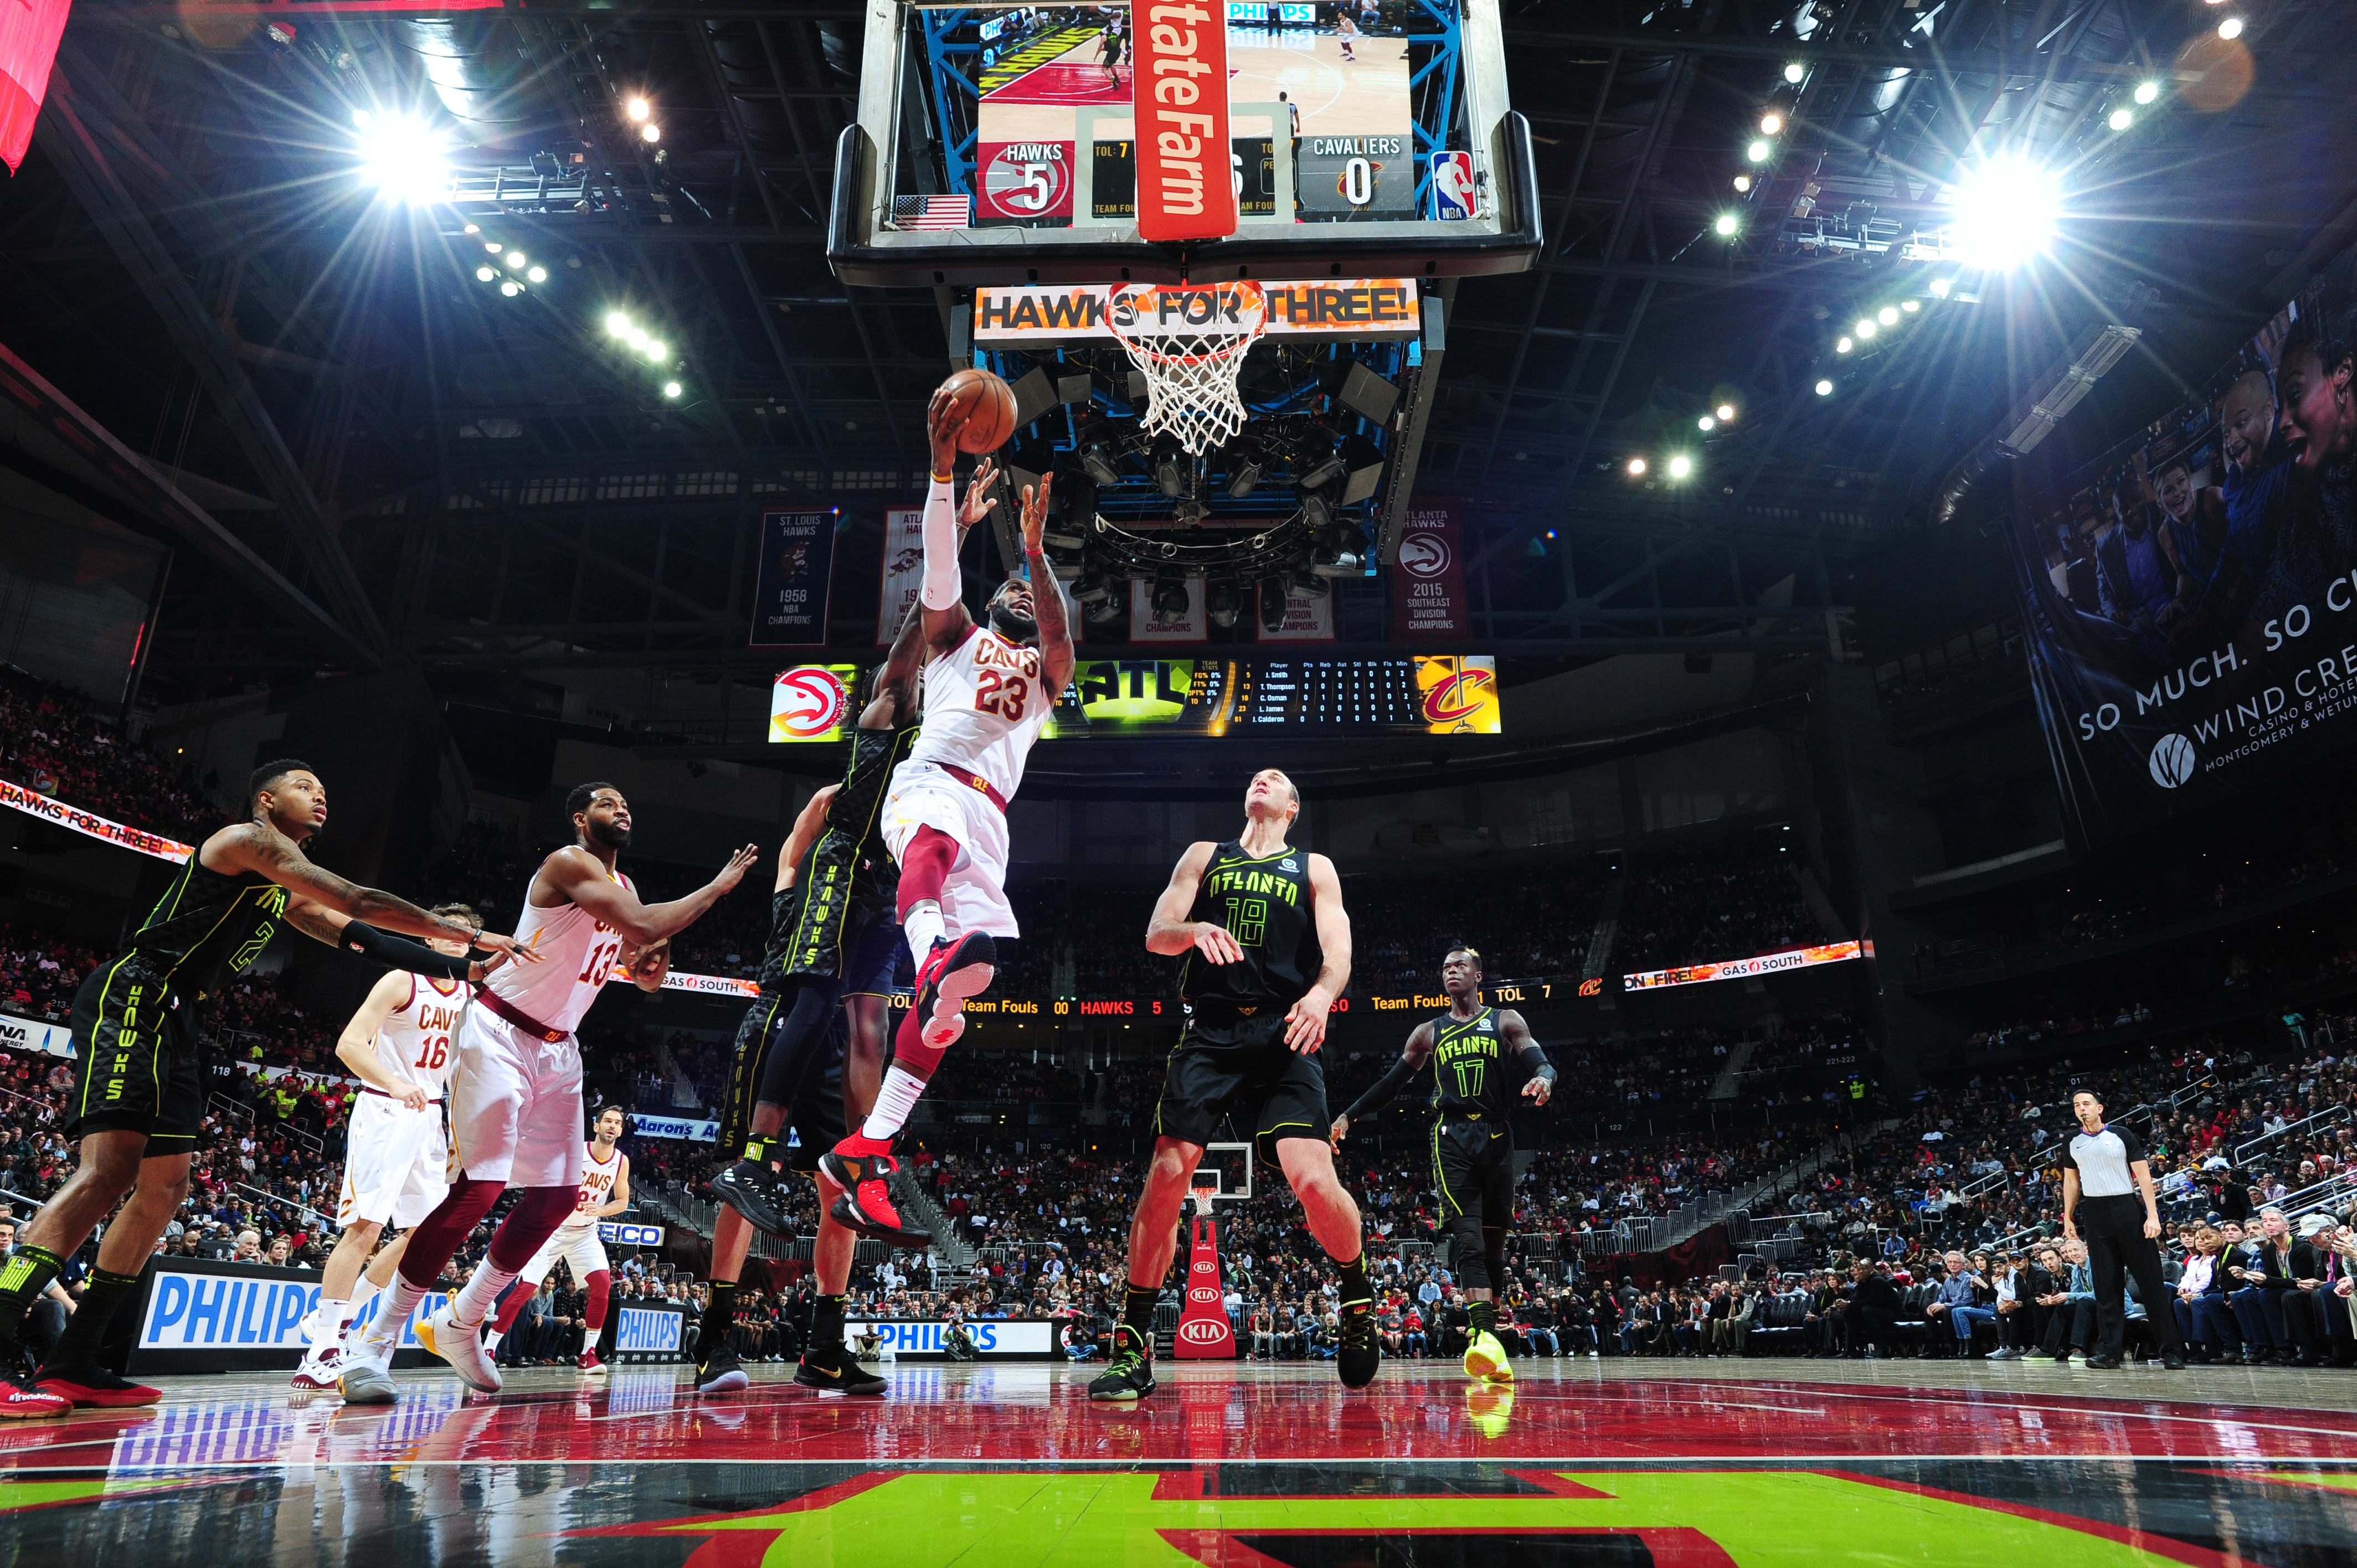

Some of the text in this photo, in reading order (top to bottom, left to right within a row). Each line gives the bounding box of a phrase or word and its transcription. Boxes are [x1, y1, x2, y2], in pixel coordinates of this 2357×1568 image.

[1006, 143, 1063, 161] HAWKS
[1095, 142, 1127, 158] TOL: 7
[1262, 143, 1274, 153] TO
[1314, 138, 1400, 155] CAVALIERS
[1023, 163, 1048, 210] 5
[1345, 157, 1372, 205] 0
[1095, 204, 1116, 213] TEAM
[1241, 202, 1253, 210] AM
[1443, 207, 1461, 219] NBA
[981, 287, 1409, 329] HAWKS FOR THREE!
[780, 515, 820, 526] ST. LOUIS
[1406, 510, 1448, 519] TLANTA
[783, 526, 816, 536] HAWKS
[779, 589, 807, 602] 1958
[1413, 583, 1443, 596] 2015
[783, 605, 799, 613] NBA
[1287, 599, 1311, 608] NTRAL
[1407, 598, 1450, 607] SOUTHEAST
[768, 615, 811, 625] CHAMPIONS
[1286, 610, 1311, 619] VISION
[1414, 609, 1447, 618] DIVISION
[1146, 623, 1191, 632] CHAMPIONS
[1282, 621, 1318, 631] AMPIONS
[1408, 620, 1454, 630] CHAMPIONS
[974, 637, 1038, 679] CAVS
[2079, 604, 2310, 741] SO MUCH. SO
[1082, 661, 1186, 706] ATL
[974, 669, 1028, 722] 23
[2193, 687, 2285, 745] WIND
[2248, 707, 2298, 737] CASINO
[2304, 700, 2313, 711] &
[2205, 724, 2294, 772] MONTGOMERY
[2301, 718, 2310, 729] &
[972, 776, 989, 792] CLE
[1, 785, 163, 854] HAWKS FOR THREE!
[1210, 871, 1298, 907] ATLANTA
[577, 940, 619, 988] 13
[1722, 955, 1803, 976] GAS SOUTH
[699, 980, 739, 993] SOUTH
[1624, 969, 1692, 990] ON FIRE!
[1372, 996, 1408, 1010] Team
[1414, 994, 1451, 1008] Fouls
[1496, 987, 1525, 1002] TOL
[1542, 984, 1551, 998] 7
[963, 1000, 996, 1013] Team
[1001, 1000, 1038, 1014] Fouls
[1054, 1001, 1069, 1015] 00
[1080, 1001, 1134, 1015] HAWKS
[1152, 1001, 1161, 1014] 5
[415, 1034, 449, 1070] 16
[1439, 1036, 1498, 1065] ATLANTA
[1826, 1055, 1856, 1065] 221-222
[212, 1065, 230, 1076] 118
[1453, 1059, 1484, 1097] 17
[2071, 1077, 2081, 1085] 01
[636, 1116, 693, 1136] Aaron's
[1195, 1291, 1214, 1299] KIA
[617, 1310, 678, 1349] PHILIPS
[1188, 1324, 1220, 1339] KIA
